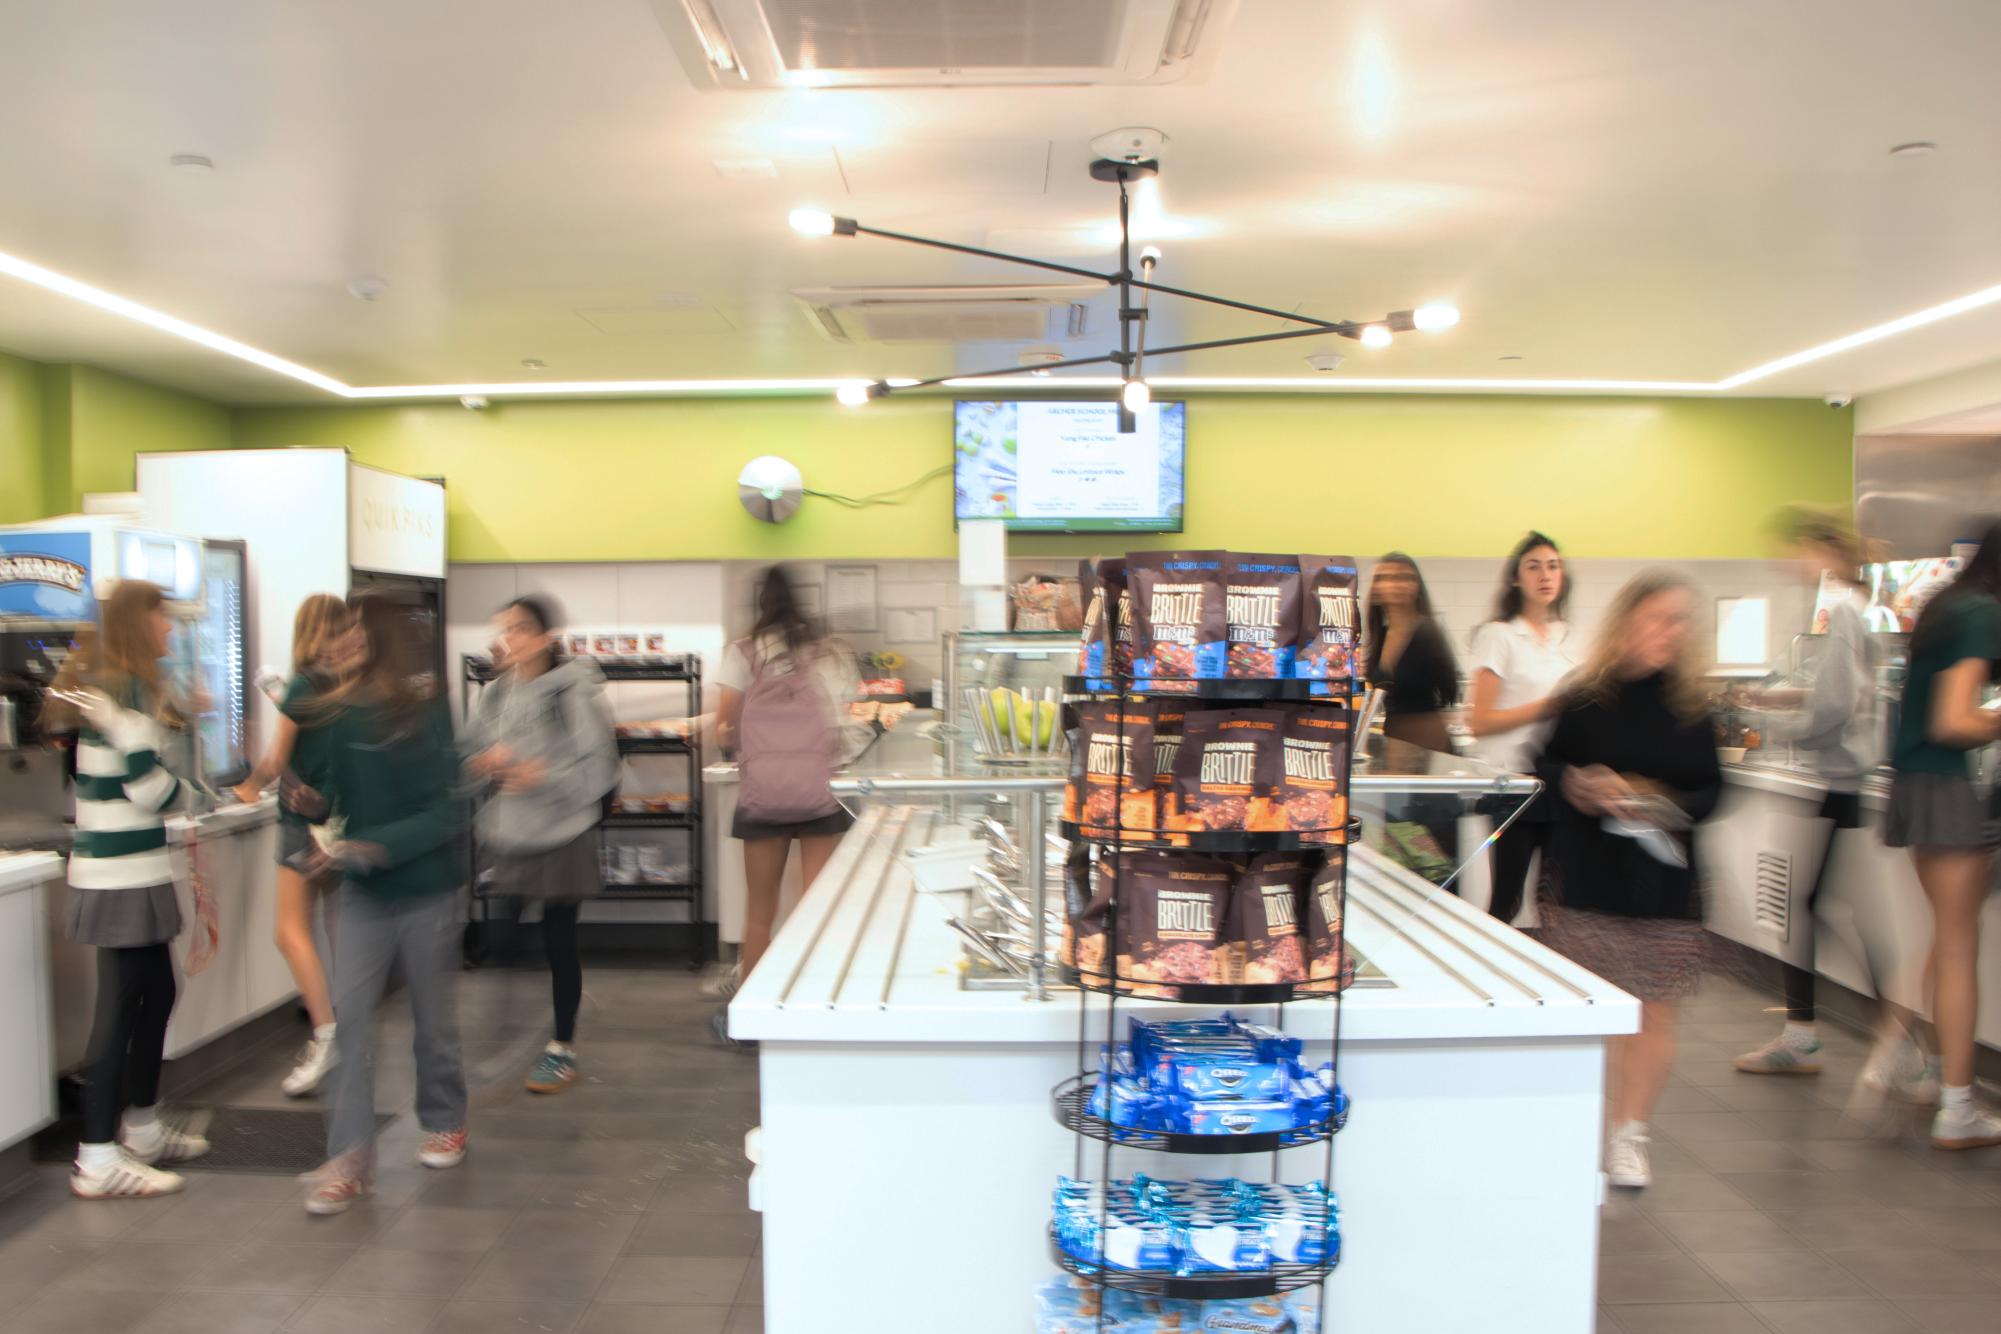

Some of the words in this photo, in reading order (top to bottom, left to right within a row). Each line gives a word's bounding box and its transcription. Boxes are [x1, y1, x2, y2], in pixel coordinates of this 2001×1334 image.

[1152, 583, 1205, 593] BROWNIE
[1227, 585, 1280, 595] BROWNIE
[1150, 592, 1203, 625] BRITTLE
[1226, 594, 1281, 627] BRITTLE
[1204, 742, 1257, 752] BROWNIE
[1284, 736, 1334, 750] BROWNIE
[1200, 751, 1257, 785] BRITTLE
[1284, 746, 1337, 780] BRITTLE
[1158, 899, 1216, 931] BRITTLE
